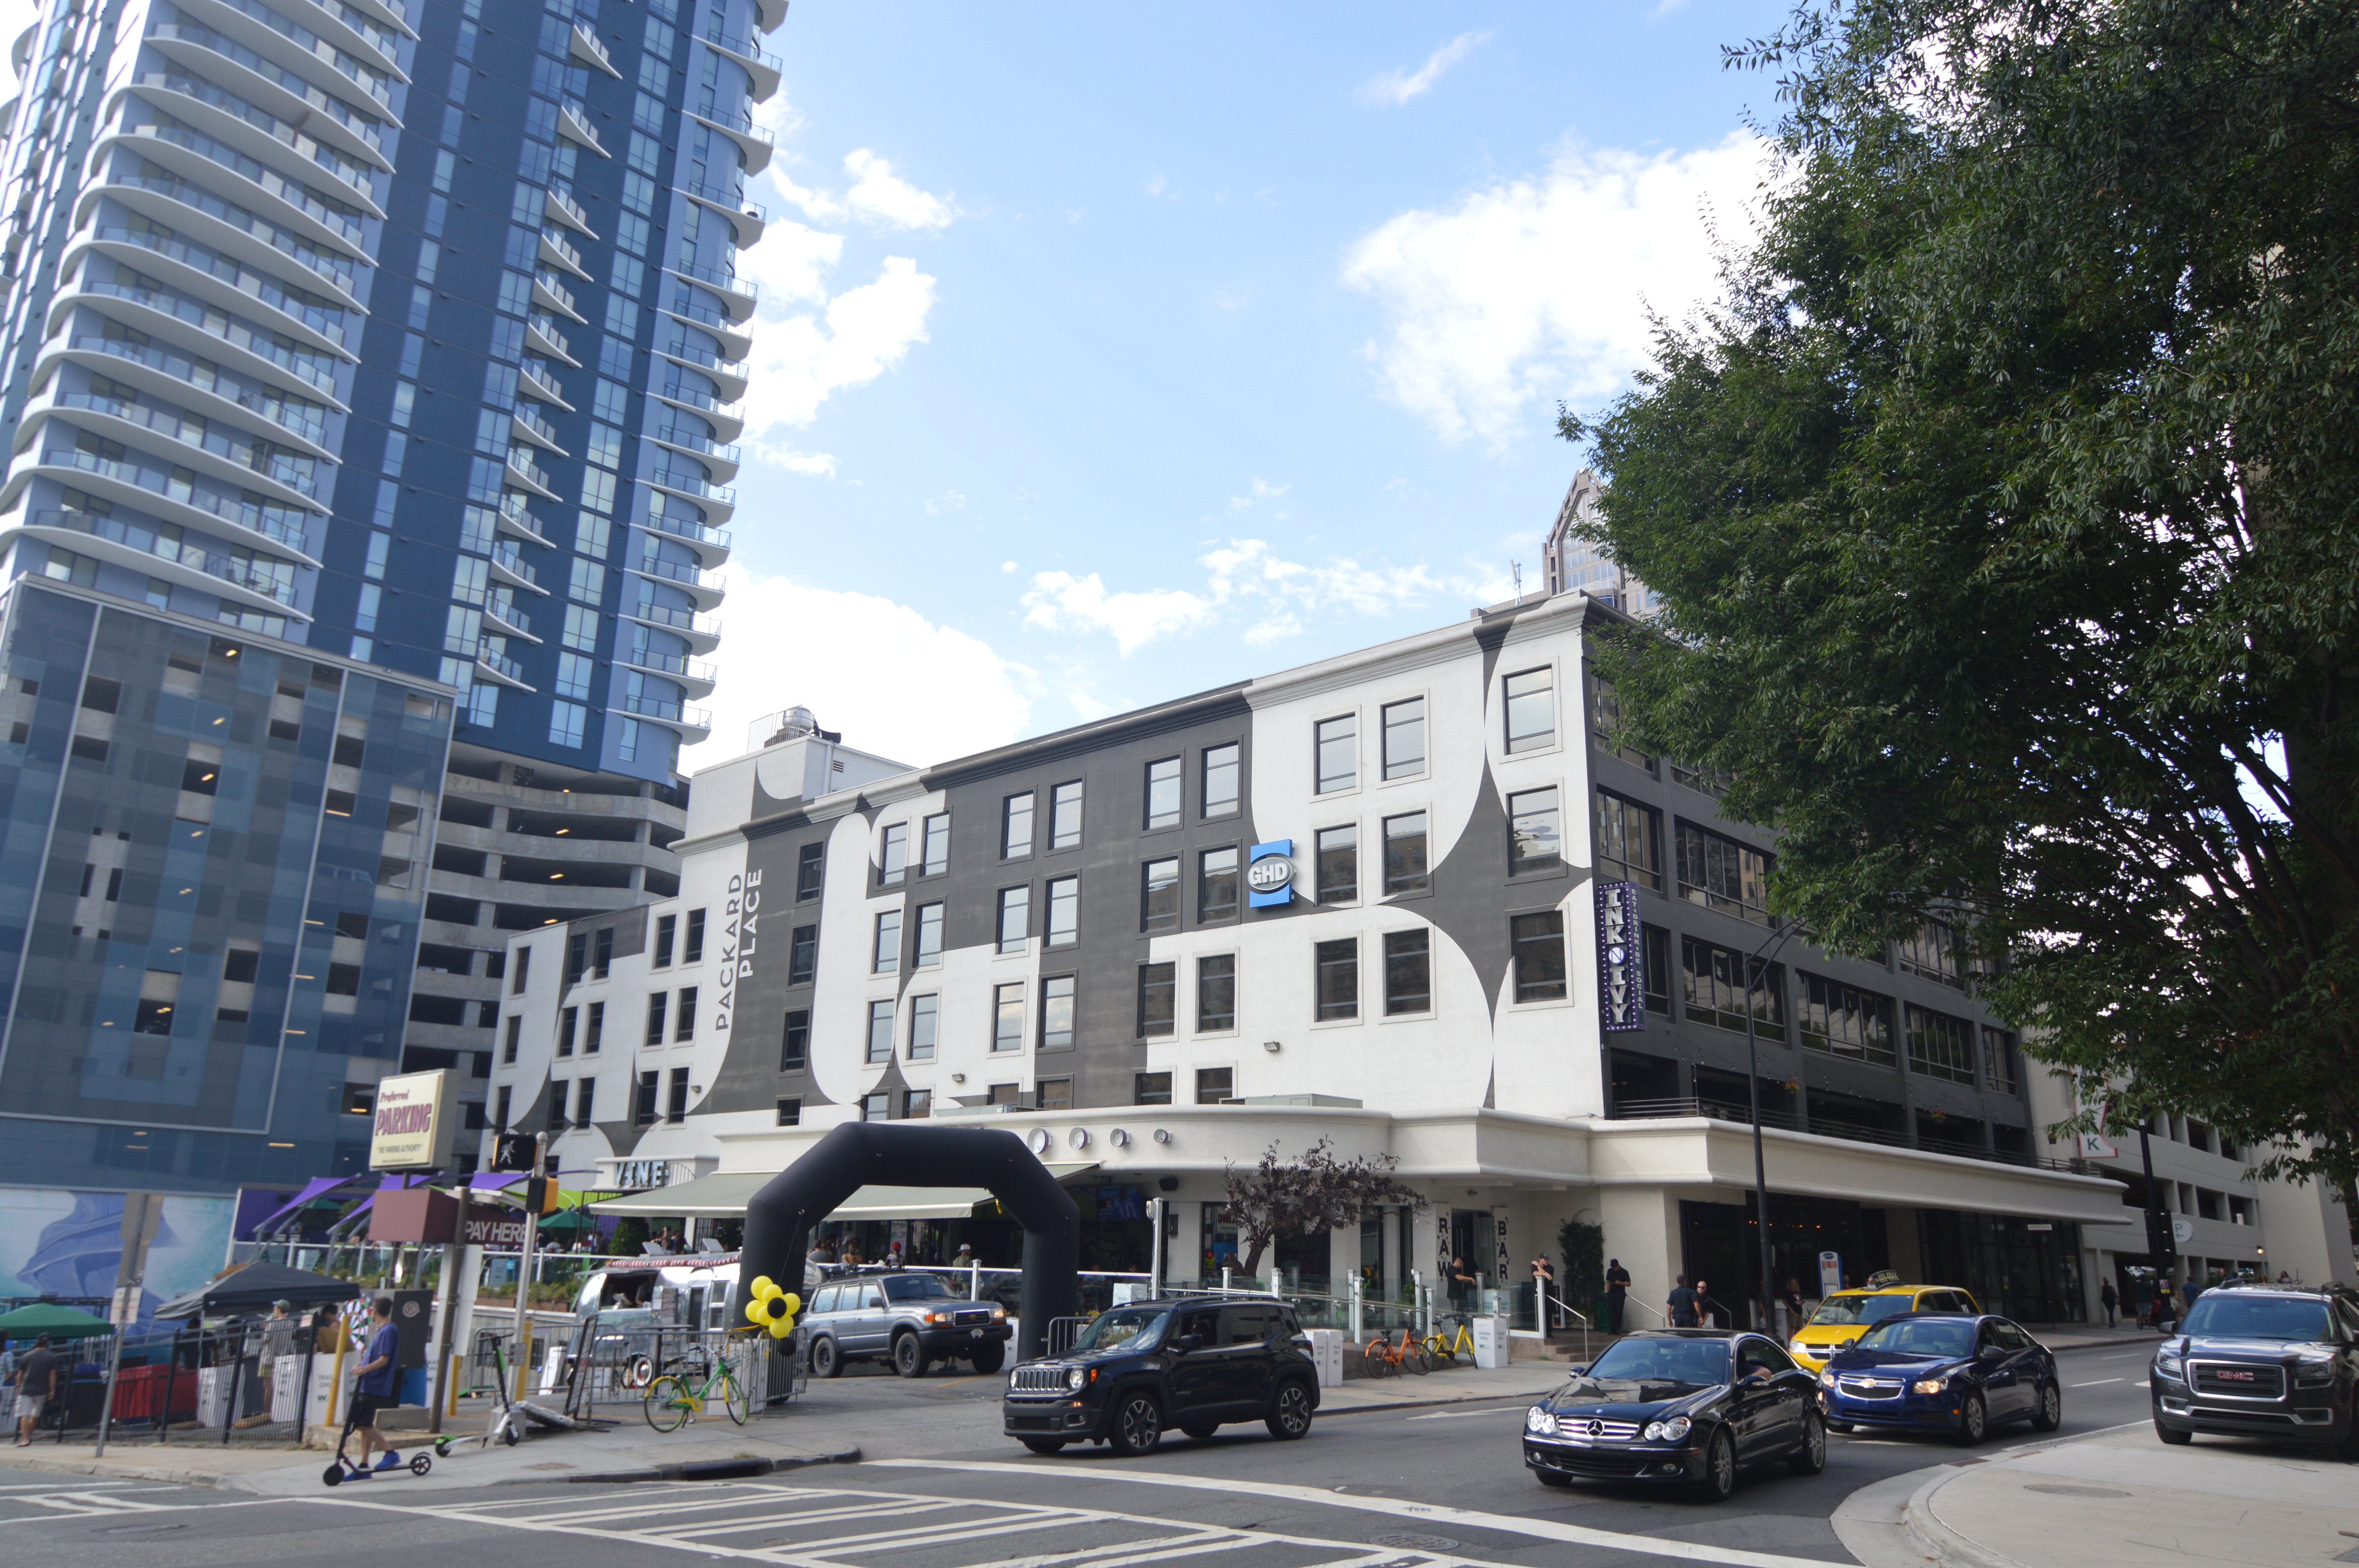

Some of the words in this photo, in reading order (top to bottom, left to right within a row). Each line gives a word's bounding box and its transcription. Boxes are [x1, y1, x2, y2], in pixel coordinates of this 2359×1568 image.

[1249, 863, 1288, 885] GHD
[738, 869, 762, 978] PLACE
[1604, 888, 1625, 944] INK
[716, 875, 742, 1031] PACKARD
[1608, 966, 1628, 1023] IVY
[379, 1089, 410, 1103] Preferred
[375, 1102, 433, 1136] PARKING
[614, 1161, 665, 1186] VINE
[465, 1220, 491, 1241] PAY
[491, 1222, 526, 1242] HERE
[2175, 1223, 2183, 1232] P
[1438, 1217, 1451, 1278] RAW
[1498, 1220, 1508, 1280] BAR
[2216, 1370, 2254, 1381] GMC
